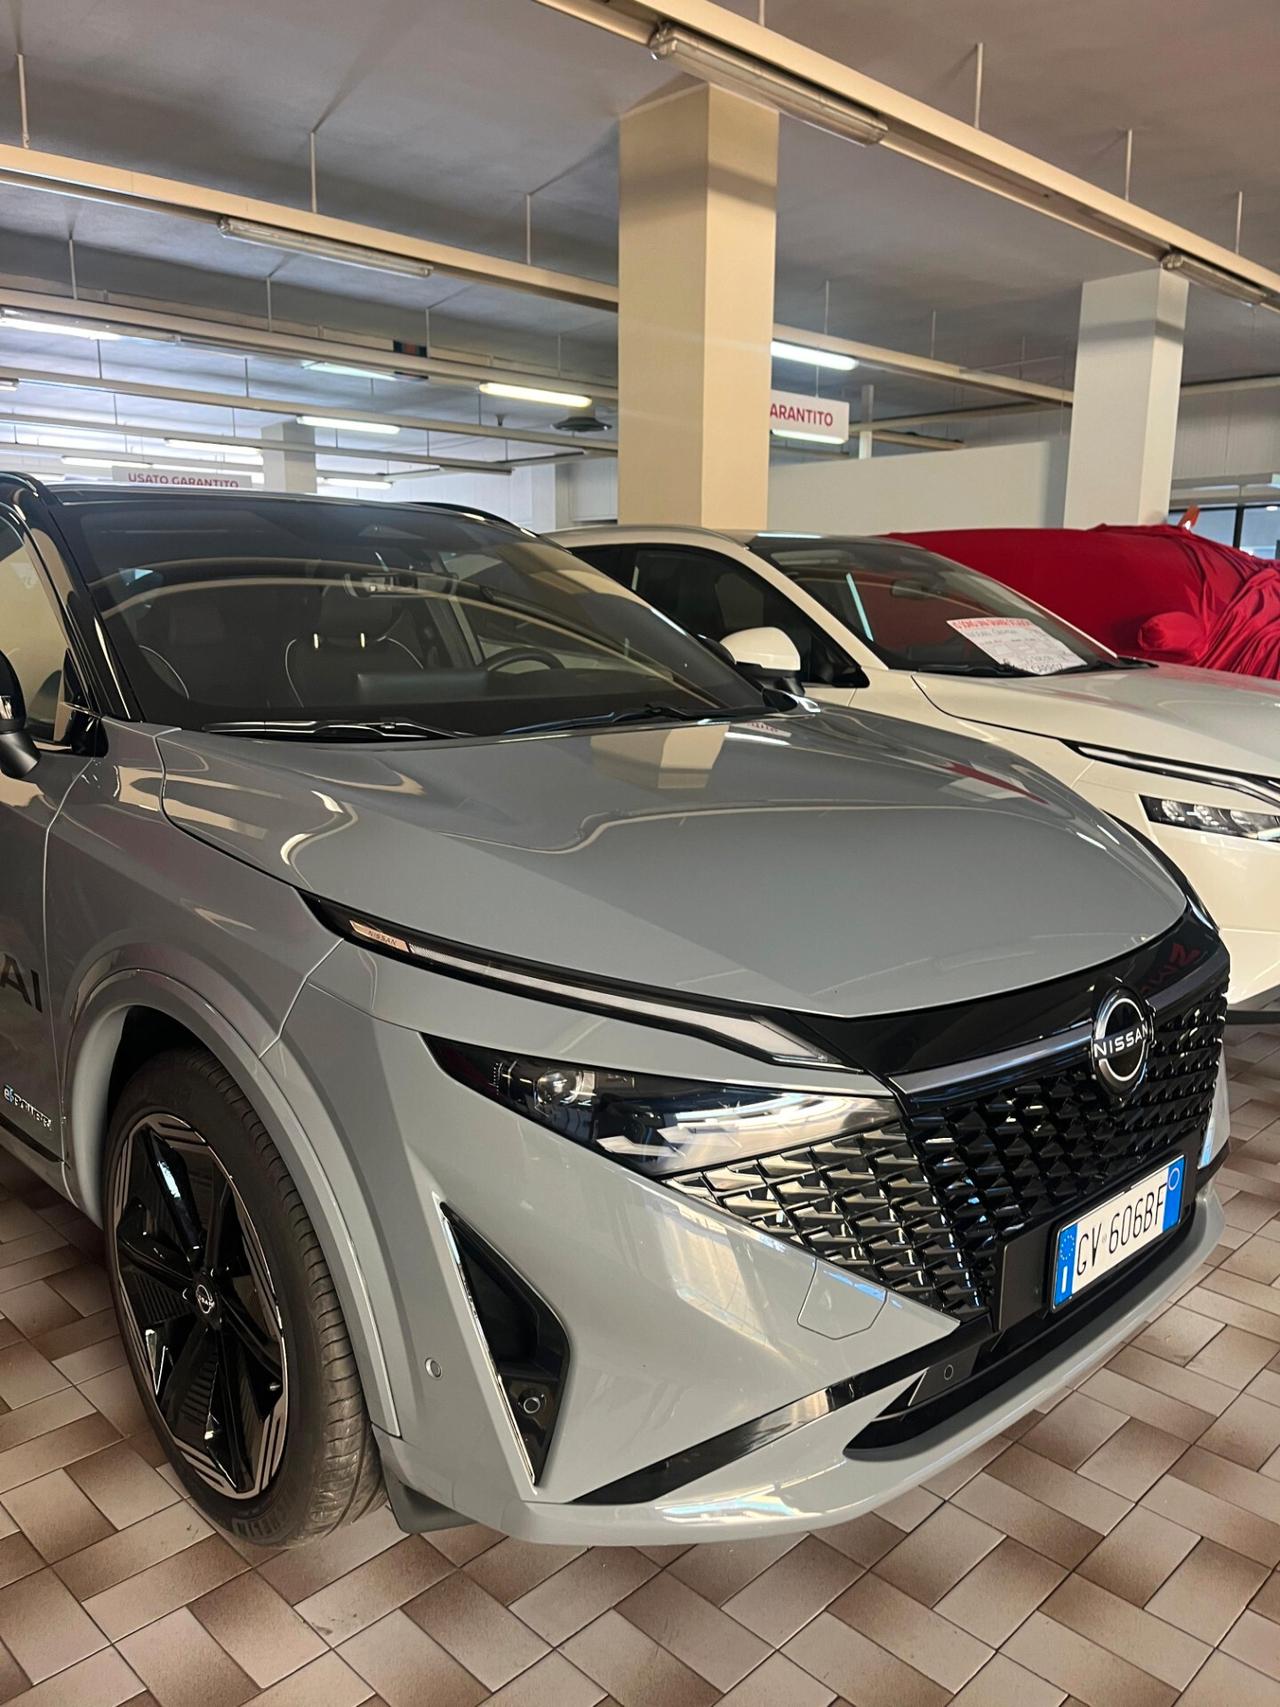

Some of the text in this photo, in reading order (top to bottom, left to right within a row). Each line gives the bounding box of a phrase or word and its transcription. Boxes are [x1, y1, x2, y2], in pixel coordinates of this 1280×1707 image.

[770, 403, 833, 427] ARANTITO
[128, 472, 239, 488] USATO GARANTITO
[368, 930, 397, 946] NISSAN
[1093, 1023, 1148, 1058] NISSAN
[1076, 1182, 1168, 1276] GV 606BF
